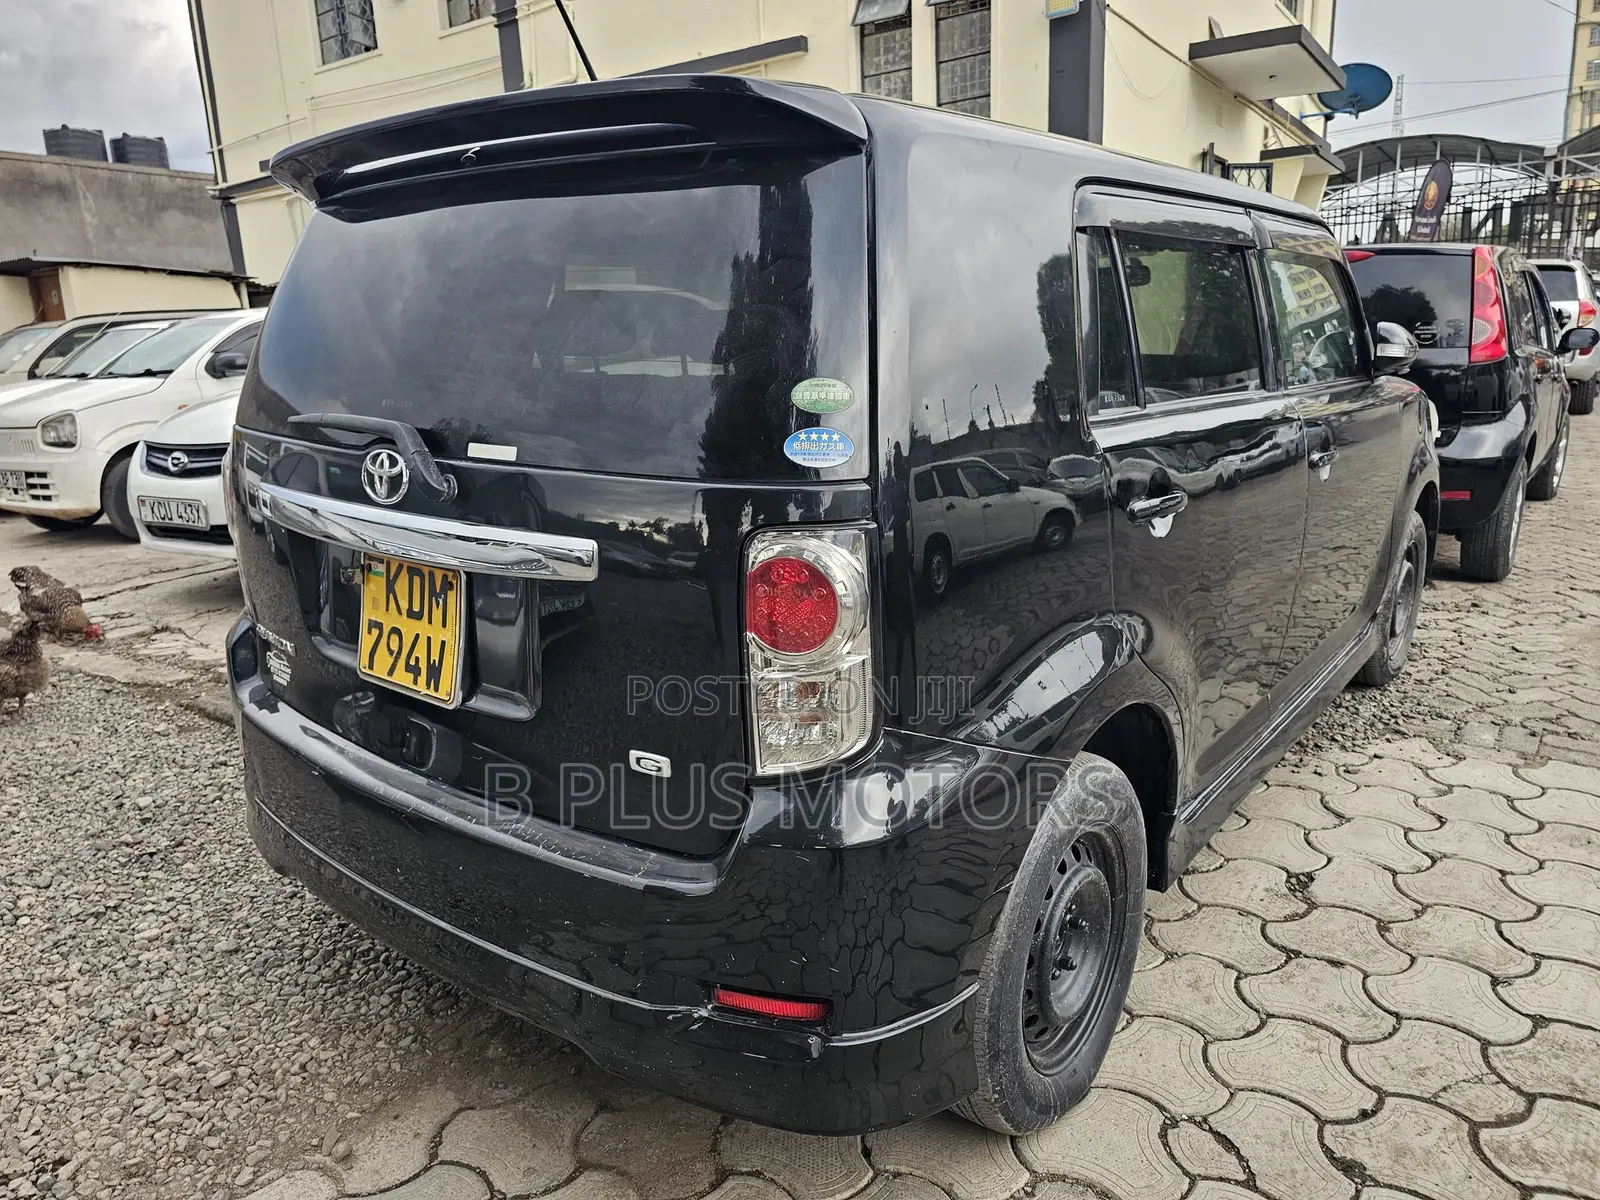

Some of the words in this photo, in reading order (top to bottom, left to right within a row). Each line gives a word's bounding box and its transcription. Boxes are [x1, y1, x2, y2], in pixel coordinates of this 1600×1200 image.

[149, 501, 173, 521] KCU
[177, 502, 204, 525] 433X
[385, 559, 450, 629] KDM
[367, 618, 446, 693] 794W
